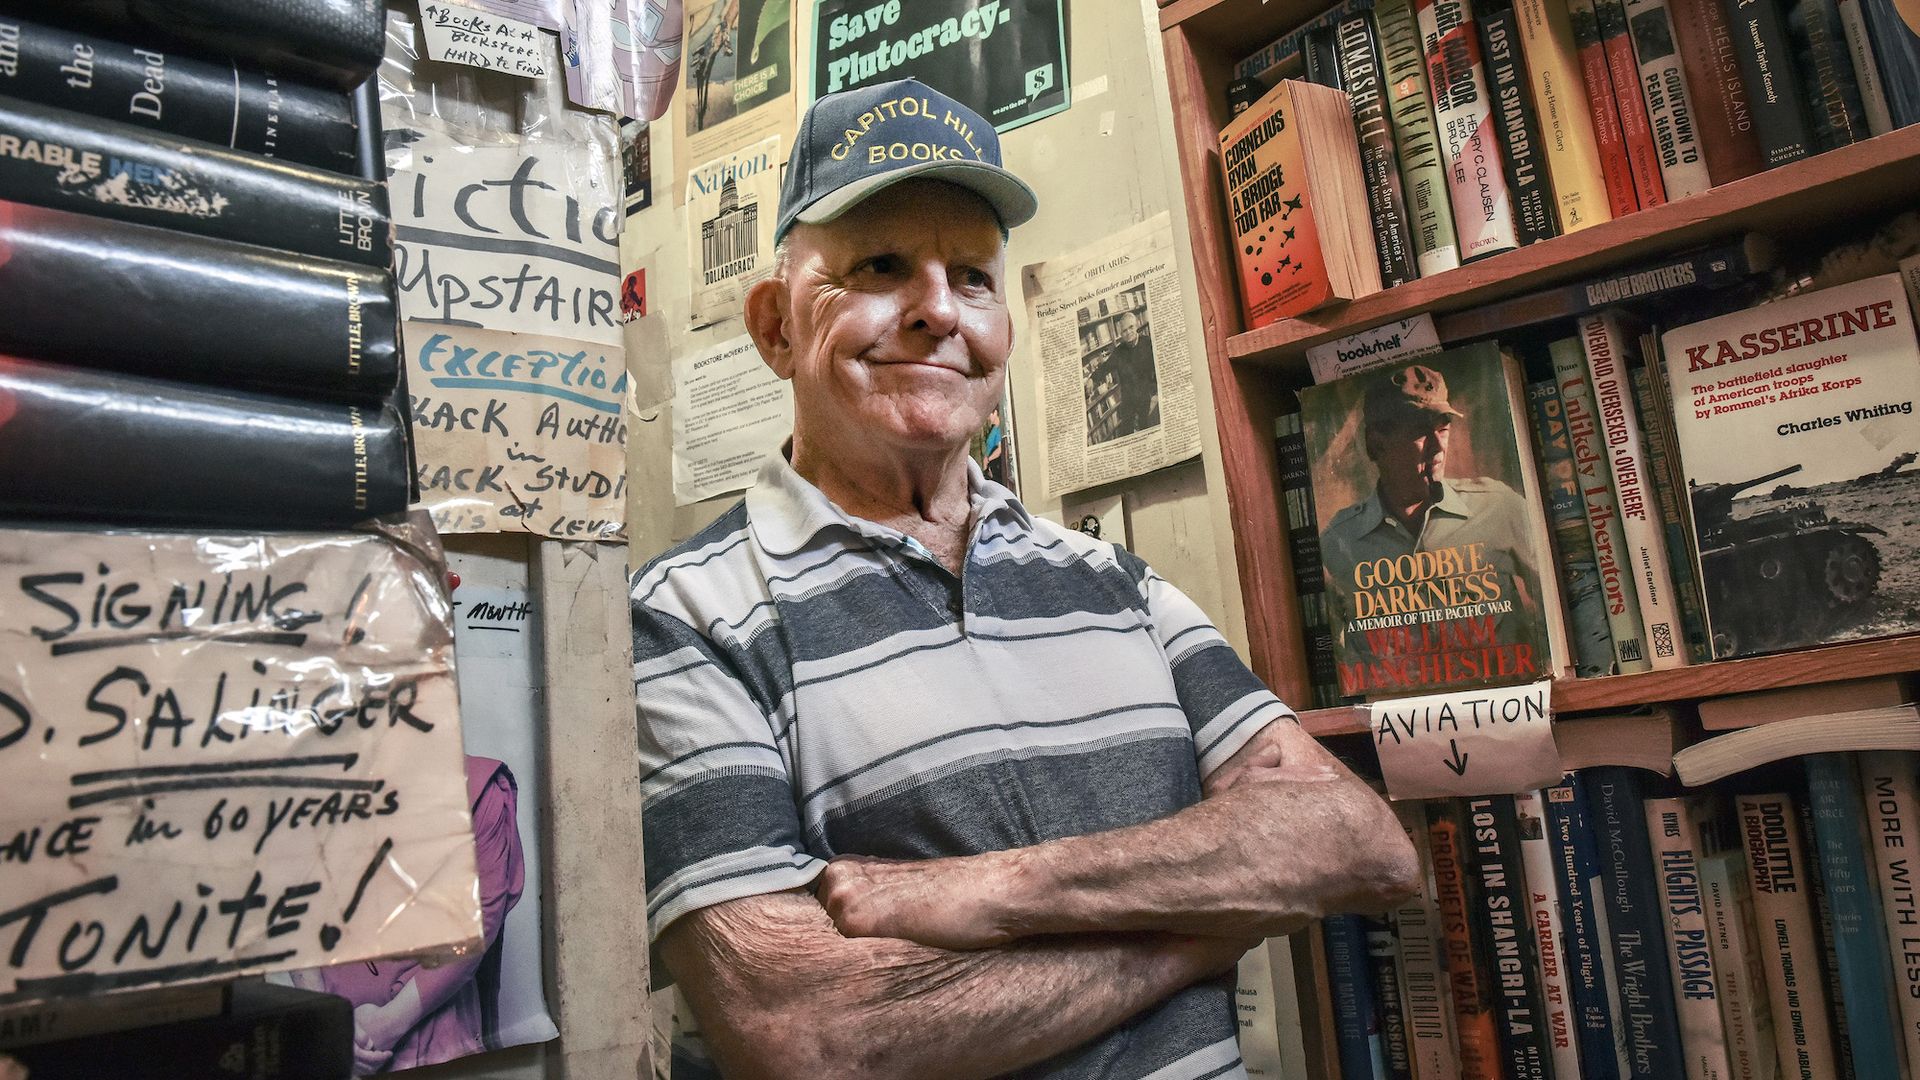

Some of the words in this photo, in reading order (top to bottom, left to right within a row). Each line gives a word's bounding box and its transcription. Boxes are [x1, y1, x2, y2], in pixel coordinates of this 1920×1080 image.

[829, 0, 900, 50] Save
[1487, 19, 1509, 60] LOST
[1749, 19, 1765, 50] Maxwell
[827, 0, 1010, 93] Plutocracy.
[1756, 49, 1768, 71] Taylor
[0, 22, 21, 77] and
[60, 43, 95, 89] the
[129, 48, 165, 120] Dead
[734, 73, 758, 92] THERE
[760, 70, 768, 80] IS
[1341, 18, 1387, 144] BOMBSHELL
[1443, 36, 1478, 109] HARBOR
[1498, 62, 1516, 83] IN
[1542, 71, 1552, 95] Going
[1708, 3, 1720, 22] FOR
[1714, 25, 1736, 73] HELL'S
[1728, 76, 1751, 133] ISLAND
[1762, 70, 1778, 105] Kennedy
[1547, 94, 1557, 118] Home
[1582, 61, 1601, 97] Stephen
[1592, 106, 1611, 145] Ambrose
[1608, 51, 1628, 88] Stephen
[1618, 97, 1638, 137] Ambrose
[831, 97, 937, 161] CAPITOL
[1456, 118, 1470, 139] and
[1466, 113, 1482, 158] HENRY
[1553, 118, 1560, 131] to
[1646, 73, 1663, 115] PEARL
[1655, 115, 1679, 169] HARBOR
[1664, 67, 1694, 144] COUNTDOWN
[1683, 147, 1698, 164] TO
[0, 133, 102, 177] RABLE
[868, 143, 964, 165] BOOKS
[1225, 110, 1286, 171] CORNELIUS
[1375, 144, 1384, 159] The
[1446, 121, 1462, 161] BRUCE
[1454, 159, 1466, 185] LEE
[1500, 85, 1537, 188] SHANGRI-LA
[1554, 129, 1565, 152] Glory
[1770, 150, 1805, 163] SCHUSTER
[1771, 145, 1793, 156] SIMON
[1227, 154, 1257, 192] RYAN
[1363, 148, 1375, 184] Unknown
[1377, 161, 1388, 187] Secret
[1474, 155, 1484, 167] C.
[1633, 144, 1655, 190] Americans
[1232, 194, 1241, 217] A
[1241, 164, 1285, 205] BRIDGE
[1370, 184, 1381, 212] Atomic
[1382, 187, 1392, 210] Story
[1415, 178, 1431, 212] William
[1475, 166, 1495, 222] CLAUSEN
[1531, 189, 1546, 231] MITCHELL
[357, 190, 372, 252] BROWN
[1235, 211, 1258, 237] TOO
[1259, 191, 1282, 223] FAR
[1376, 213, 1385, 230] Spy
[1387, 211, 1393, 221] of
[1420, 210, 1436, 224] H.
[1520, 195, 1535, 233] ZUCKOFF
[1379, 230, 1393, 275] Conspiracy
[1389, 223, 1403, 262] America's
[1422, 223, 1438, 252] Honan
[1470, 236, 1498, 250] CROWN
[705, 255, 756, 286] DOLLAROCRACY
[1084, 255, 1130, 279] OBITUARIES
[1586, 284, 1620, 306] BAND
[1630, 262, 1697, 296] BROTHERS
[1036, 305, 1058, 319] Bridge
[1059, 300, 1077, 312] Street
[1078, 292, 1096, 305] Books
[1095, 282, 1120, 296] founder
[1133, 263, 1166, 284] proprietor
[1337, 334, 1401, 364] bookshelf
[1685, 300, 1896, 373] KASSERINE
[694, 353, 723, 370] BOOKSTORE
[1692, 382, 1715, 397] The
[1717, 368, 1783, 390] battlefield
[1785, 352, 1848, 375] slaughter
[1693, 398, 1707, 408] of
[1708, 383, 1770, 405] American
[1773, 373, 1815, 392] troops
[1696, 408, 1711, 420] by
[1713, 395, 1776, 416] Rommel's
[1779, 385, 1820, 402] Afrika
[1821, 376, 1862, 395] Korps
[1544, 400, 1567, 449] DAY
[1642, 410, 1663, 455] GESTAPO
[1777, 414, 1841, 437] Charles
[1844, 401, 1913, 424] Whiting
[416, 464, 504, 492] LACK
[1615, 456, 1638, 489] OVER
[1561, 375, 1601, 477] Unlikely
[1584, 485, 1626, 617] Liberators
[1640, 546, 1651, 570] Juliet
[1354, 571, 1502, 620] DARKNESS
[1645, 570, 1658, 606] Gardiner
[1348, 621, 1357, 632] A
[1357, 614, 1402, 632] MEMOIR
[1404, 612, 1418, 626] OF
[1420, 608, 1443, 624] THE
[1445, 602, 1486, 622] PACIFIC
[1487, 600, 1513, 615] WAR
[1366, 615, 1498, 657] WILLIAM
[1339, 643, 1537, 698] MANCHESTER
[1378, 690, 1544, 744] AVIATION
[1470, 800, 1500, 855] LOST
[1742, 803, 1751, 812] A
[1874, 777, 1904, 848] MORE
[0, 817, 102, 864] NCE
[205, 799, 249, 839] 60
[1559, 816, 1570, 841] Two
[1601, 783, 1614, 824] David
[1609, 829, 1630, 913] McCullough
[1760, 803, 1796, 894] DOOLITTLE
[1564, 844, 1581, 897] Hundred
[1743, 814, 1773, 894] BIOGRAPHY
[1434, 831, 1466, 933] PROPHETS
[1482, 865, 1506, 888] IN
[1662, 850, 1701, 917] FLIGHTS
[1711, 882, 1722, 910] DAVID
[1889, 859, 1918, 926] WITH
[1534, 893, 1546, 903] A
[1572, 900, 1585, 934] Years
[1537, 910, 1558, 978] CARRIER
[1577, 937, 1589, 950] of
[1617, 929, 1642, 957] The
[1716, 911, 1729, 950] BLATNER
[1775, 919, 1787, 949] LOWELL
[1450, 939, 1470, 964] OF
[1488, 896, 1534, 1036] SHANGRI-LA
[1579, 952, 1594, 988] Flight
[1673, 929, 1715, 1001] PASSAGE
[1780, 950, 1796, 987] THOMAS
[1902, 938, 1920, 999] LESS
[1378, 965, 1397, 1011] SHANE
[1454, 972, 1478, 1014] WAR
[1547, 984, 1561, 1004] AT
[1622, 959, 1648, 1008] Wright
[1725, 972, 1735, 990] THE
[1787, 989, 1799, 1010] AND
[1408, 972, 1443, 1040] MORNING
[1727, 993, 1745, 1046] FLYING
[1385, 1013, 1407, 1072] OSBORN
[1551, 1011, 1568, 1049] WAR
[1627, 1010, 1658, 1074] Brothers
[1791, 1009, 1806, 1044] EDWARD
